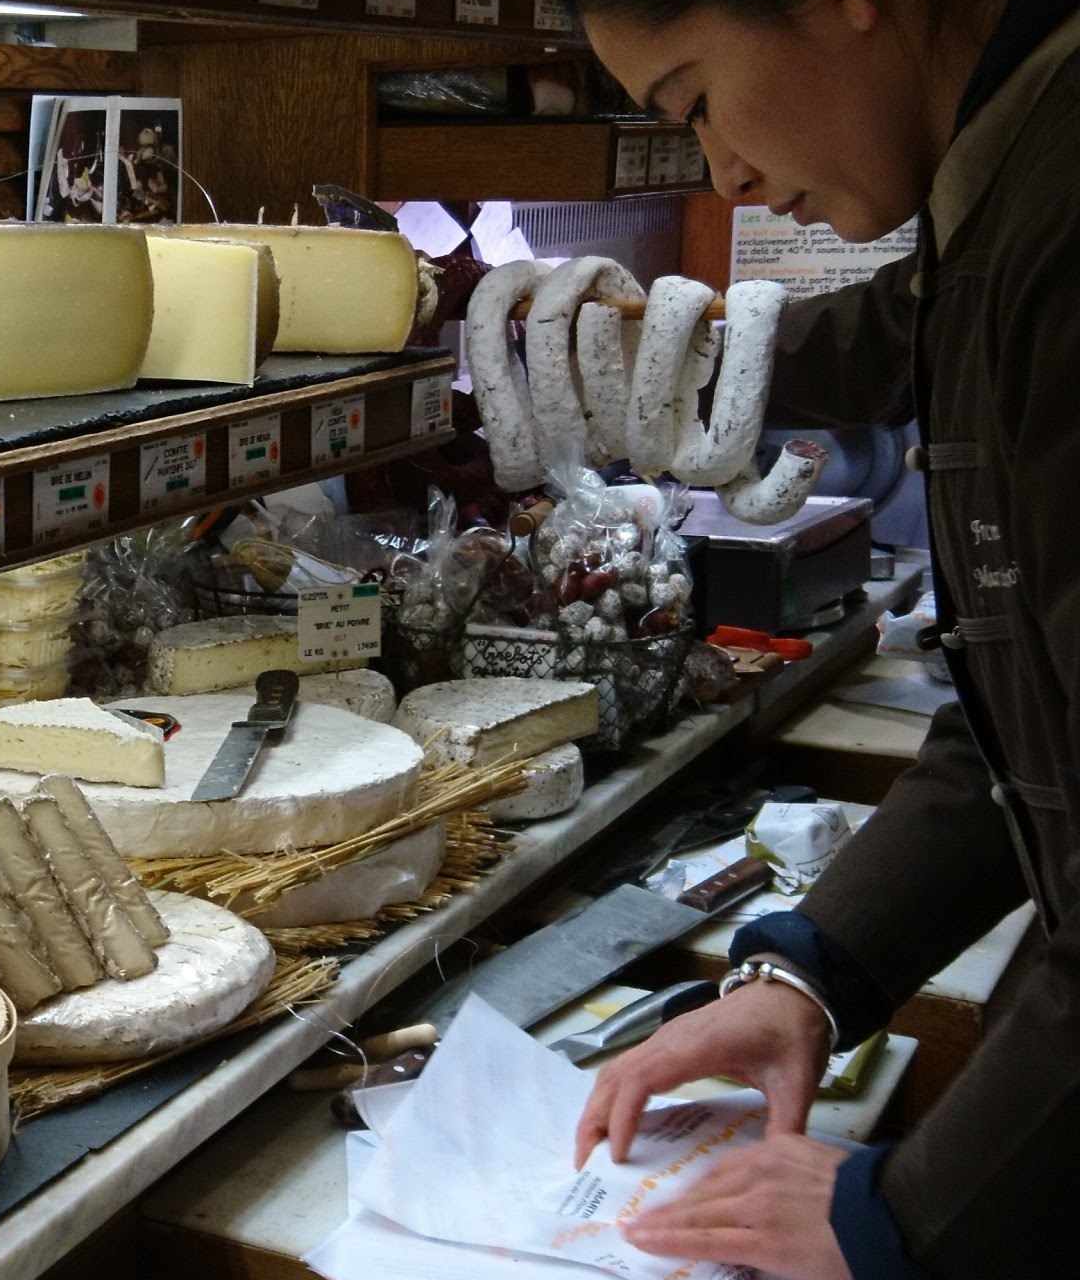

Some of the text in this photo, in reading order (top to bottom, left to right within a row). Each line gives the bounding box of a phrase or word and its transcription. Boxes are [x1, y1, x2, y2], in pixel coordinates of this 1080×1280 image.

[741, 213, 761, 224] Les
[793, 228, 807, 236] les
[737, 237, 839, 248] exclusivement partir
[751, 247, 769, 256] delà
[773, 247, 784, 255] de
[816, 246, 846, 255] soumis
[736, 255, 780, 266] équivalent
[824, 267, 837, 275] les
[809, 276, 851, 287] partir de
[163, 444, 189, 459] COMTE
[50, 473, 64, 487] BRIE
[331, 604, 350, 613] PETIT
[335, 621, 345, 629] AU
